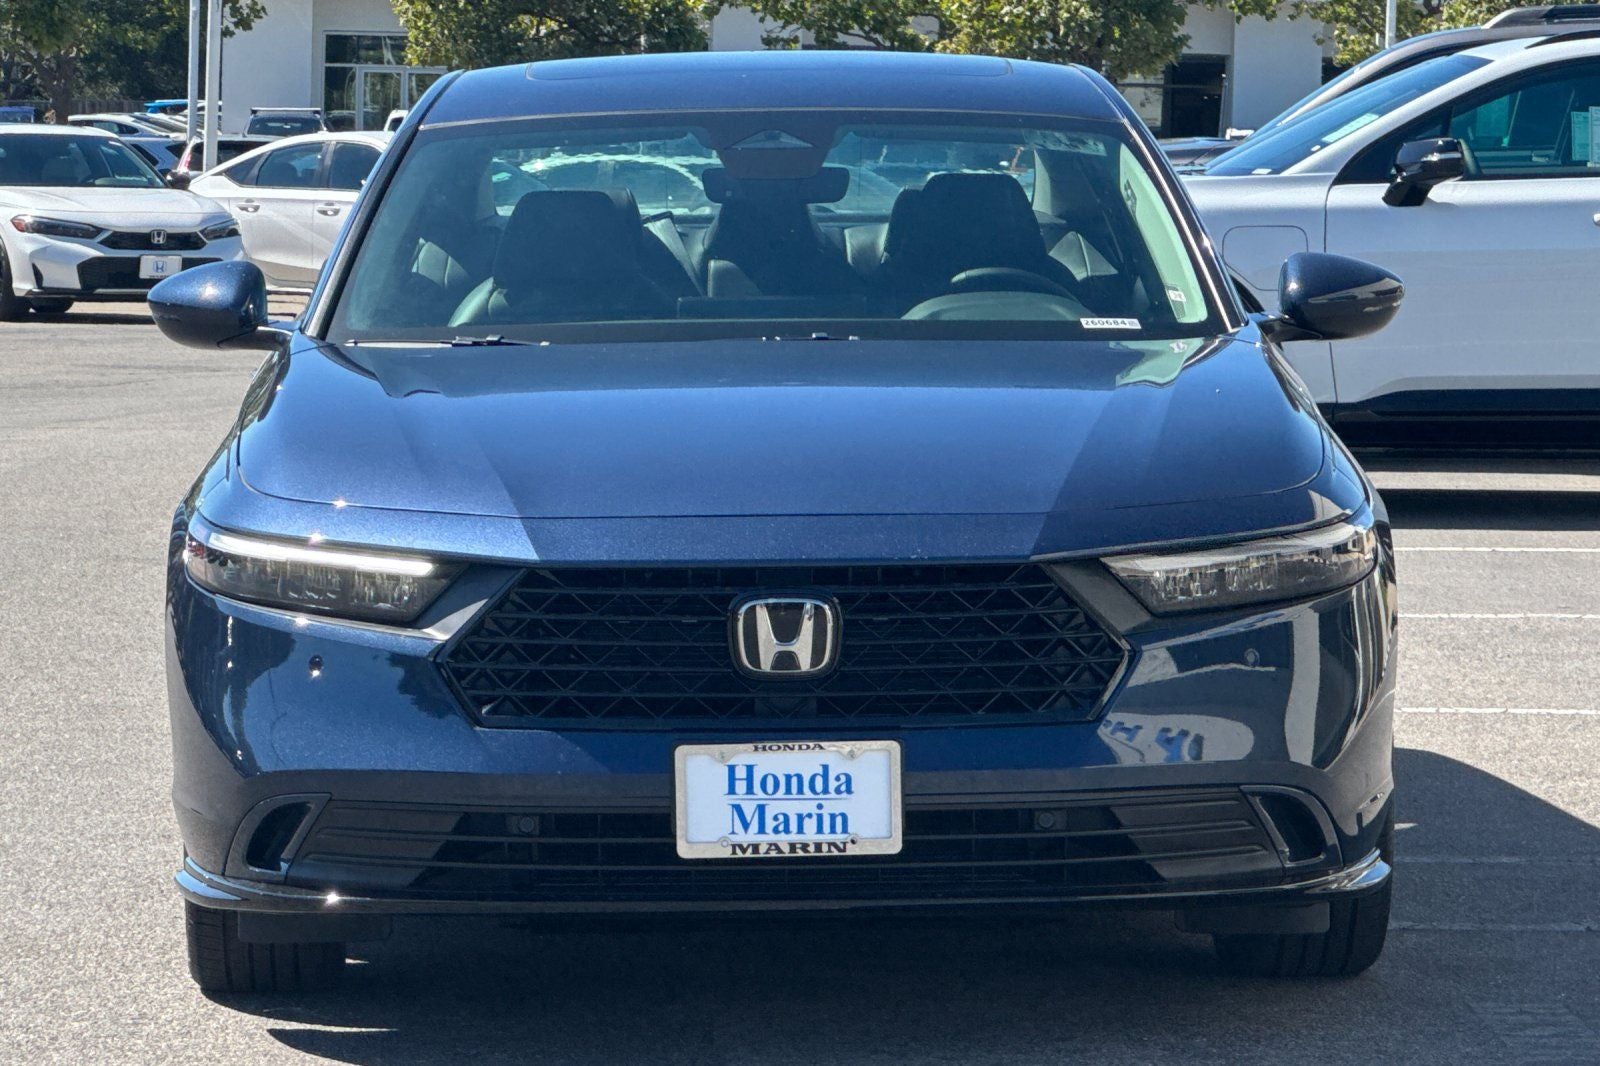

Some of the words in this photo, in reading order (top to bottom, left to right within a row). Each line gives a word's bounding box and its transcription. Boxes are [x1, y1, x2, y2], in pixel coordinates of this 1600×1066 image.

[752, 743, 826, 752] HONDA
[723, 763, 854, 796] Honda
[727, 802, 851, 836] Marin
[729, 841, 850, 856] MARIN
